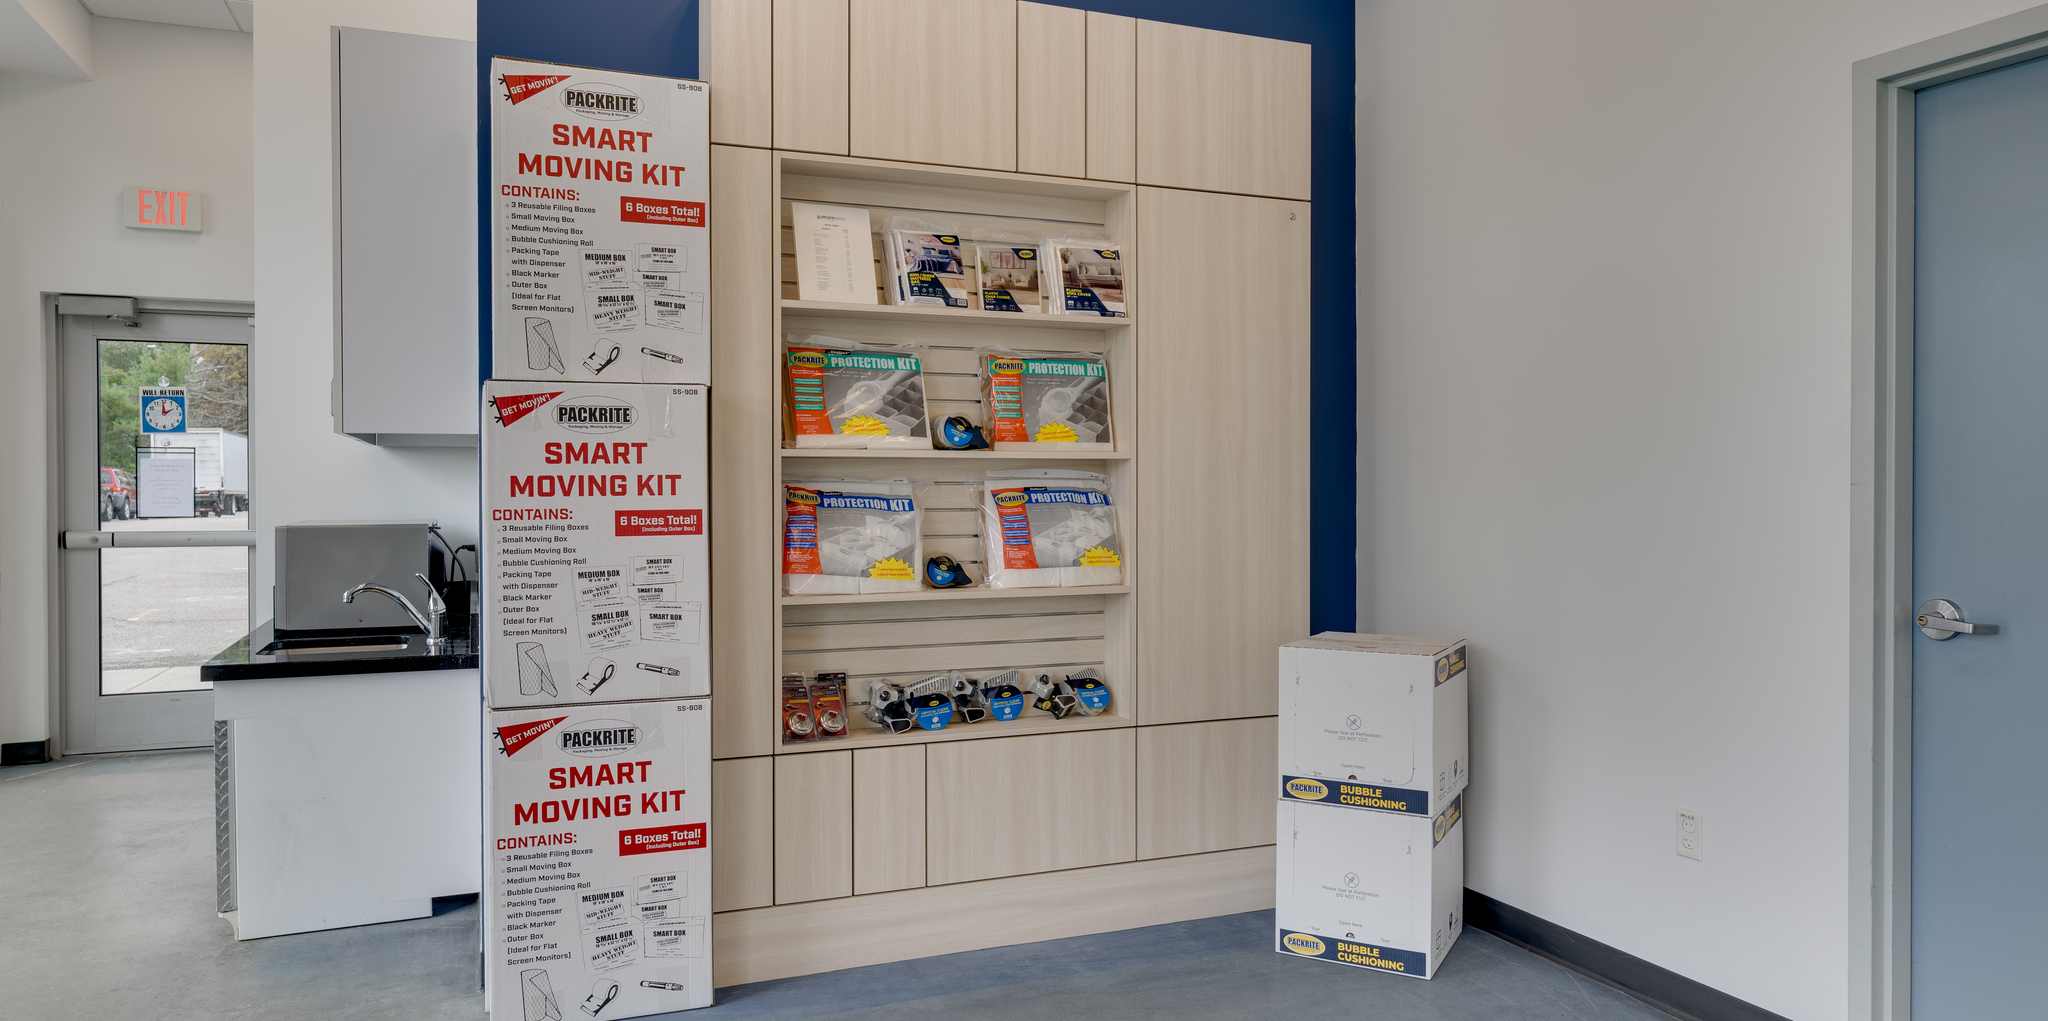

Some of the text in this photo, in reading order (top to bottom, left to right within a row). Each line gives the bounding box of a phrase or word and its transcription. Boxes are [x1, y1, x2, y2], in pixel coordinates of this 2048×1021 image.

[511, 85, 526, 94] GET
[566, 90, 637, 113] PACKRITE
[553, 124, 652, 153] SMART
[518, 153, 685, 187] MOVING KIT
[502, 184, 580, 201] CONTAINS:
[137, 189, 190, 225] EXIT
[518, 202, 550, 211] Reusable
[625, 203, 700, 217] 6 Boxes Total!
[534, 215, 559, 224] Moving
[542, 226, 568, 235] Moving
[539, 237, 578, 247] Cushioning
[511, 248, 559, 257] Packing Tape
[585, 253, 612, 261] MEDIUM
[529, 260, 566, 269] Dispenser
[511, 304, 537, 312] Screen
[793, 355, 917, 370] PACKRITE PROTECTION KIT
[1029, 362, 1085, 376] PROTECTION
[1087, 364, 1104, 377] KIT
[502, 406, 519, 417] GET
[558, 407, 631, 423] PACKRITE
[545, 442, 647, 464] SMART
[510, 475, 681, 497] MOVING KIT
[1030, 492, 1086, 503] PROTECTION
[823, 498, 888, 510] PROTECTION
[889, 499, 910, 511] KIT
[493, 508, 573, 521] CONTAINS:
[620, 515, 697, 526] 6 Boxes Total!
[509, 524, 543, 532] Reusable
[525, 536, 552, 544] Moving
[534, 547, 561, 555] Moving
[503, 559, 528, 567] Bubble
[531, 559, 571, 567] Cushioning
[503, 571, 531, 579] Packing
[578, 571, 605, 579] MEDIUM
[520, 582, 558, 591] Dispenser
[526, 593, 552, 601] Marker
[592, 610, 629, 622] SMALL BOX
[503, 629, 529, 637] Screen
[505, 734, 522, 746] GET
[563, 728, 635, 748] PACKRITE
[549, 761, 652, 790] SMART
[1291, 783, 1323, 794] PACKRITE
[1340, 784, 1382, 798] BUBBLE
[514, 790, 686, 826] MOVING KIT
[1340, 796, 1407, 810] CUSHIONING
[497, 833, 577, 850] CONTAINS:
[624, 829, 701, 845] 6 Boxes Total!
[513, 852, 548, 862] Reusable
[571, 848, 593, 857] Boxes
[530, 863, 556, 873] Moving
[507, 877, 536, 885] Medium
[539, 873, 565, 883] Moving
[507, 882, 591, 897] Bubble Cushioning Roll
[507, 897, 556, 909] Packing Tape
[582, 891, 624, 903] MEDIUM BOX
[525, 908, 563, 919] Dispenser
[530, 920, 556, 929] Marker
[508, 933, 544, 943] Outer Box
[596, 930, 633, 944] SMALL BOX
[673, 929, 686, 937] BOX
[532, 944, 542, 952] for
[543, 942, 557, 950] Flat
[1288, 937, 1320, 950] PACKRITE
[1338, 942, 1380, 957] BUBBLE
[508, 957, 534, 965] Screen
[1338, 953, 1404, 971] CUSHIONING
